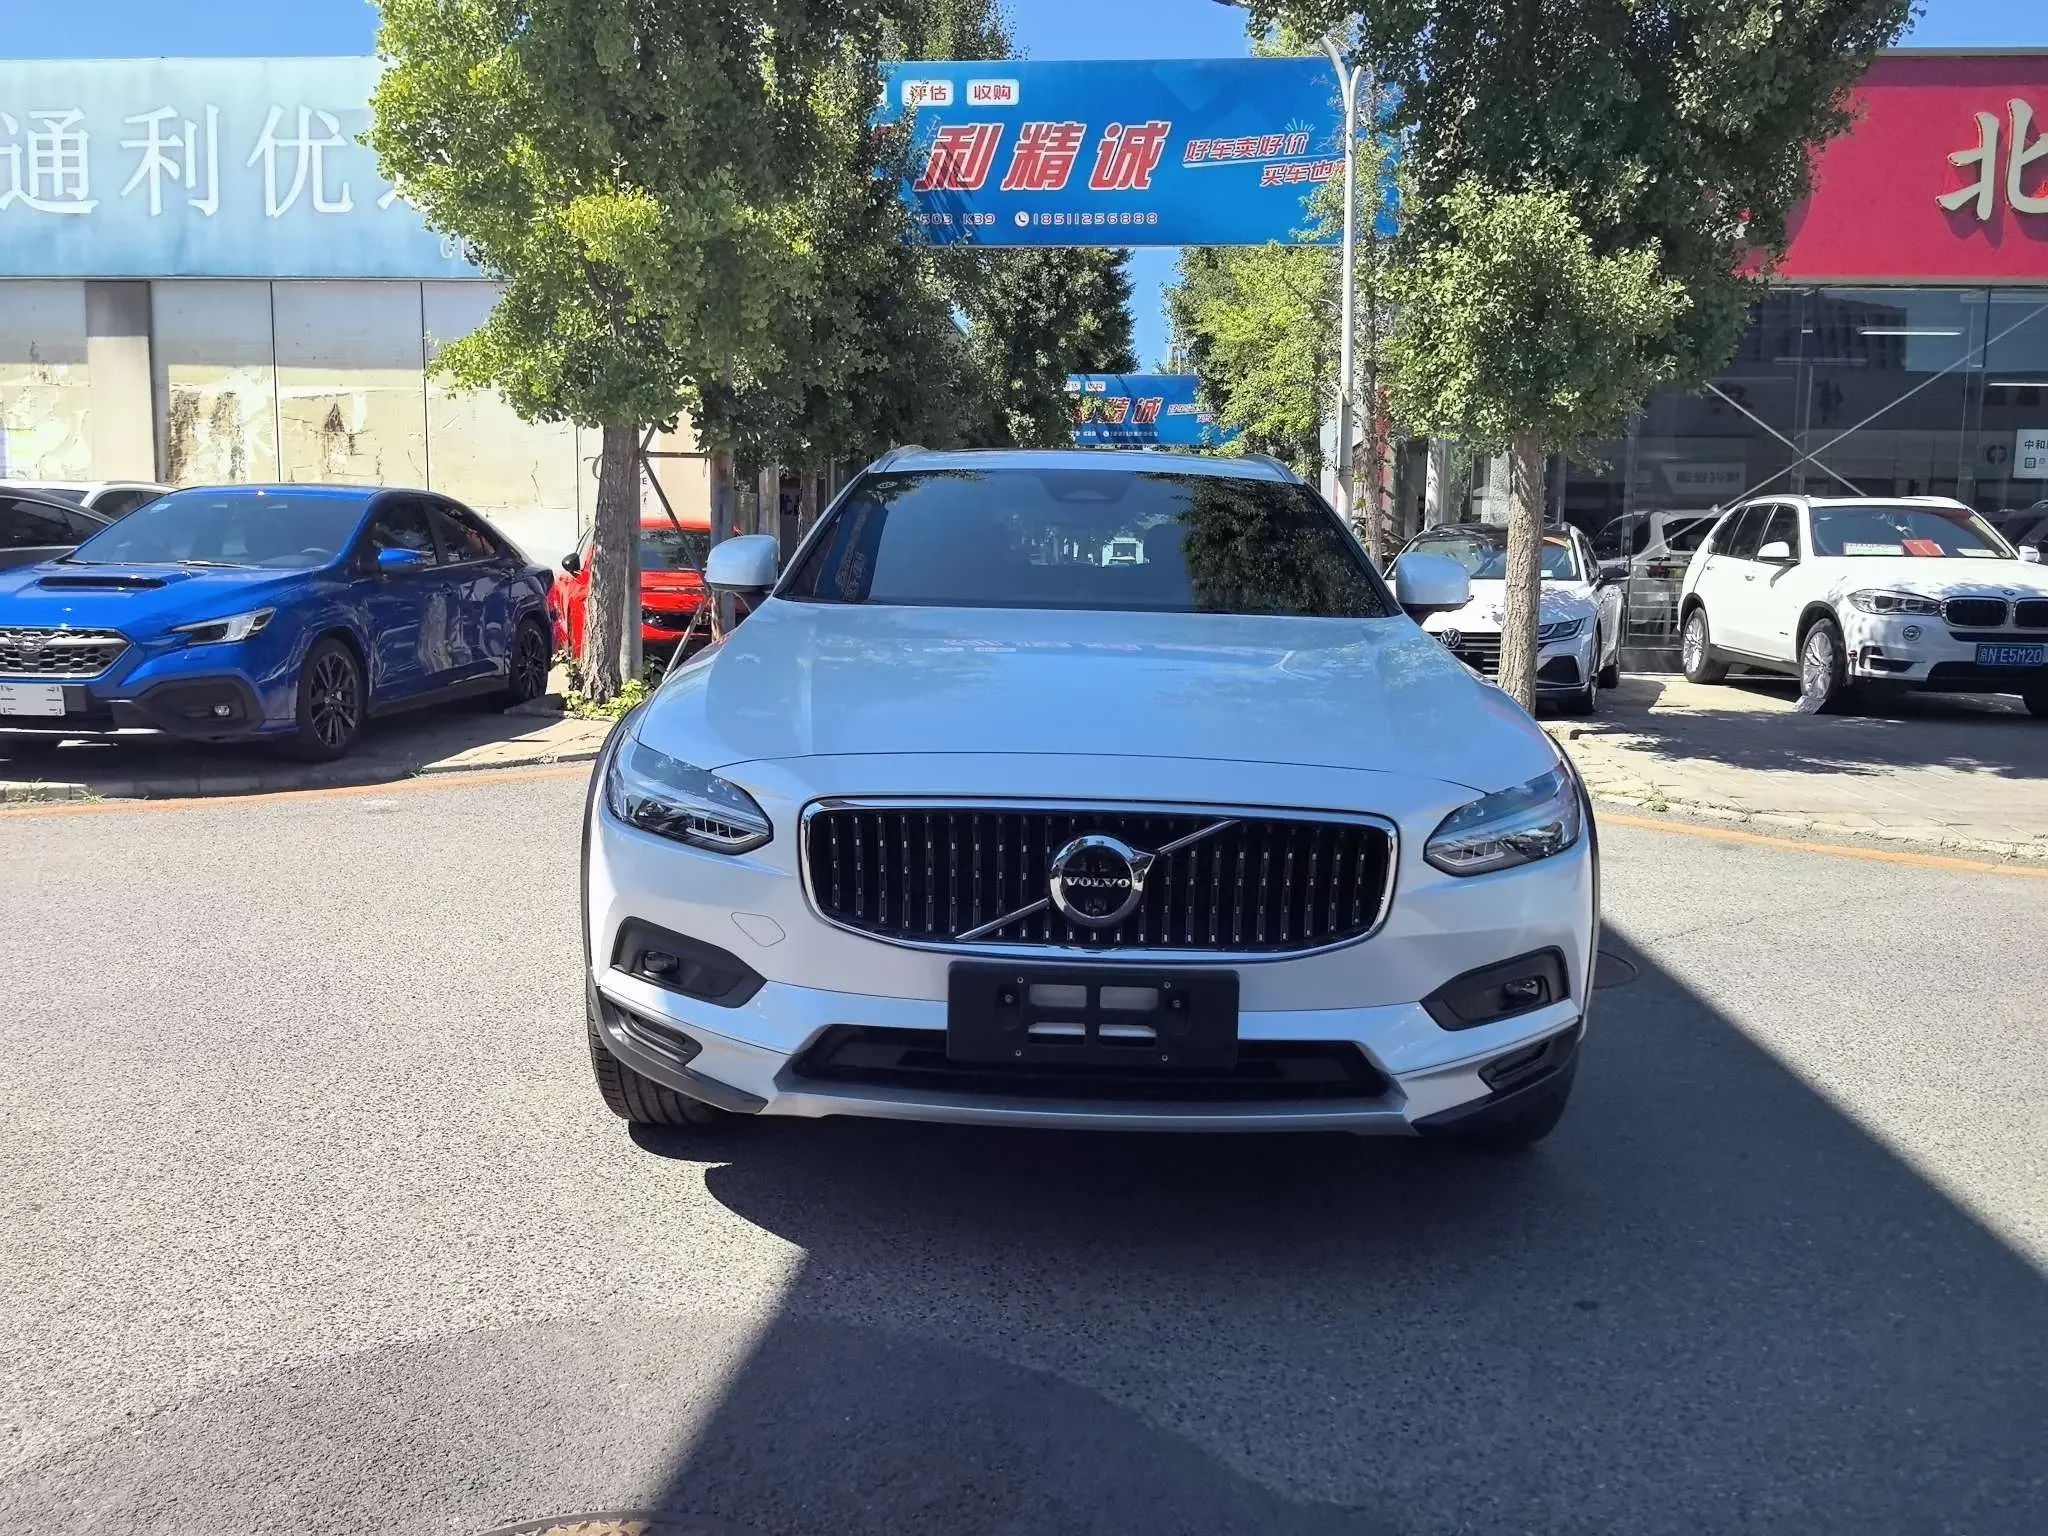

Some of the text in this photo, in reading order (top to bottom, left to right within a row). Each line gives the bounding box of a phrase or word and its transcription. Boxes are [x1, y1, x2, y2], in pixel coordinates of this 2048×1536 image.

[909, 84, 1011, 100] 评估 收购
[1183, 132, 1309, 162] 好车卖好价
[0, 103, 415, 218] 通利优
[871, 120, 1172, 192] 利精诚
[1935, 98, 2048, 221] 北
[962, 213, 996, 225] K39
[1033, 213, 1158, 225] 18511256888
[2024, 440, 2048, 450] 中和
[1064, 877, 1130, 888] VOLVO
